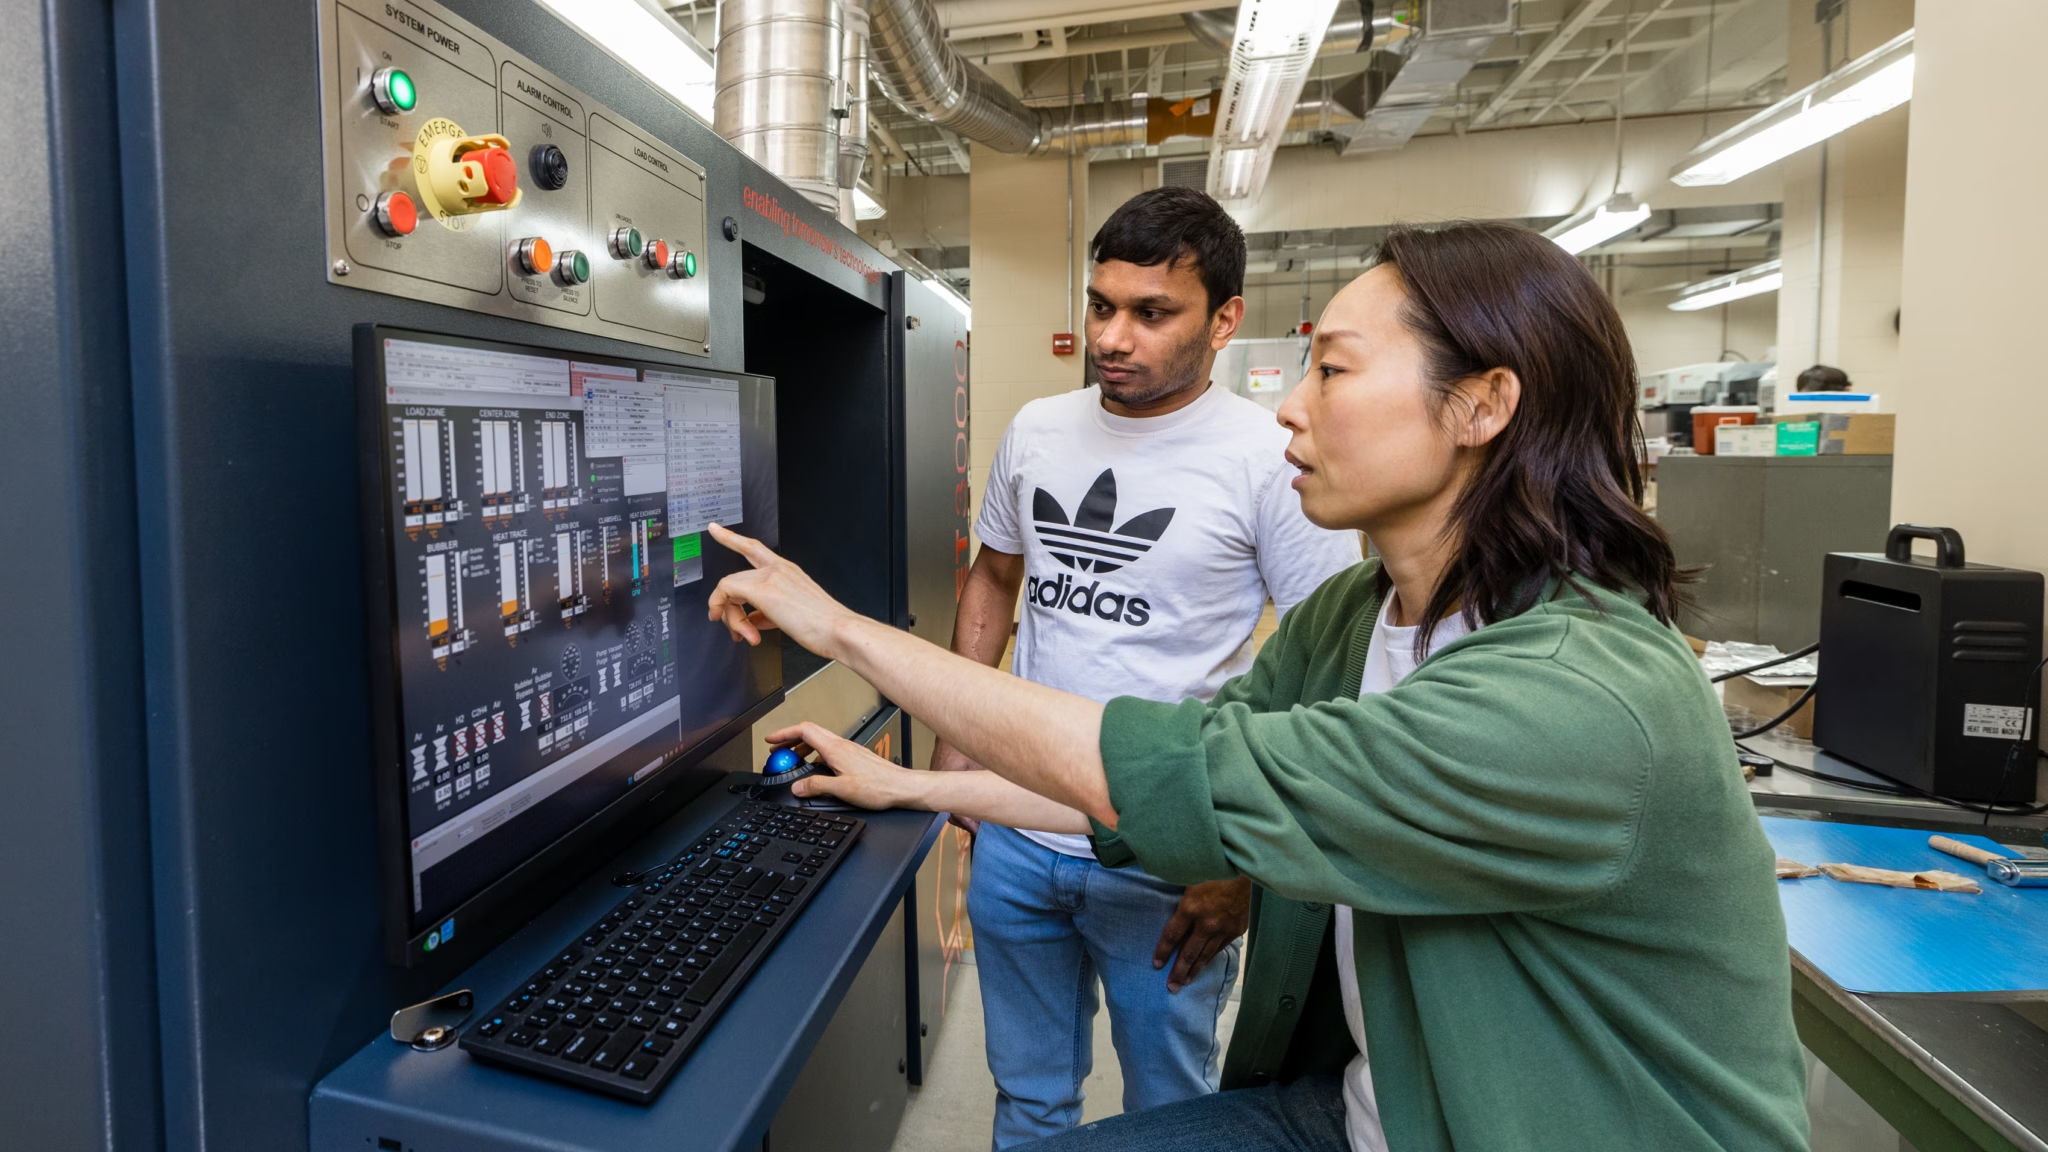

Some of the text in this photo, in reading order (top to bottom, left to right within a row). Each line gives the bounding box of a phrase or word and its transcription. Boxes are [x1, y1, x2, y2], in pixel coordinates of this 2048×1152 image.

[385, 4, 460, 55] SYSTEM POWER
[382, 51, 392, 62] ON
[517, 79, 573, 118] ALARM CONTROL
[380, 116, 400, 130] START
[419, 121, 463, 147] EMERGE
[634, 147, 669, 173] LOAD CONTROL
[440, 210, 465, 230] STOP
[743, 186, 790, 236] enabling
[792, 211, 838, 260] tomorrow's
[385, 240, 402, 249] STOP
[521, 277, 535, 285] PRESS
[563, 295, 578, 304] SILENCE
[405, 407, 446, 416] LOAD ZONE
[479, 409, 519, 418] CENTER ZONE
[545, 411, 556, 419] END
[640, 509, 661, 517] EXCHANGER
[598, 515, 622, 524] CLAMSHELL
[555, 521, 579, 531] BURN BOX
[493, 529, 527, 541] HEAT TRACE
[426, 540, 458, 553] BUBBLER
[1028, 573, 1151, 626] adidas
[658, 603, 671, 611] Pressure
[596, 649, 607, 658] Pump
[608, 644, 623, 653] Vacuum
[596, 657, 608, 666] Purge
[611, 652, 622, 660] Valve
[535, 671, 552, 683] Bubbler
[514, 679, 533, 691] Bubbler
[538, 680, 551, 691] Inject
[516, 688, 534, 700] Bypass
[493, 700, 501, 709] Air
[471, 705, 487, 718] C2H4
[455, 715, 465, 725] H2
[436, 724, 444, 733] Ar
[414, 733, 422, 742] Ar
[477, 752, 489, 764] 0.00
[457, 761, 470, 773] 0.00
[437, 771, 450, 783] 0.00
[477, 768, 489, 778] 0.00
[458, 776, 471, 788] 0.00
[438, 786, 451, 798] 0.50
